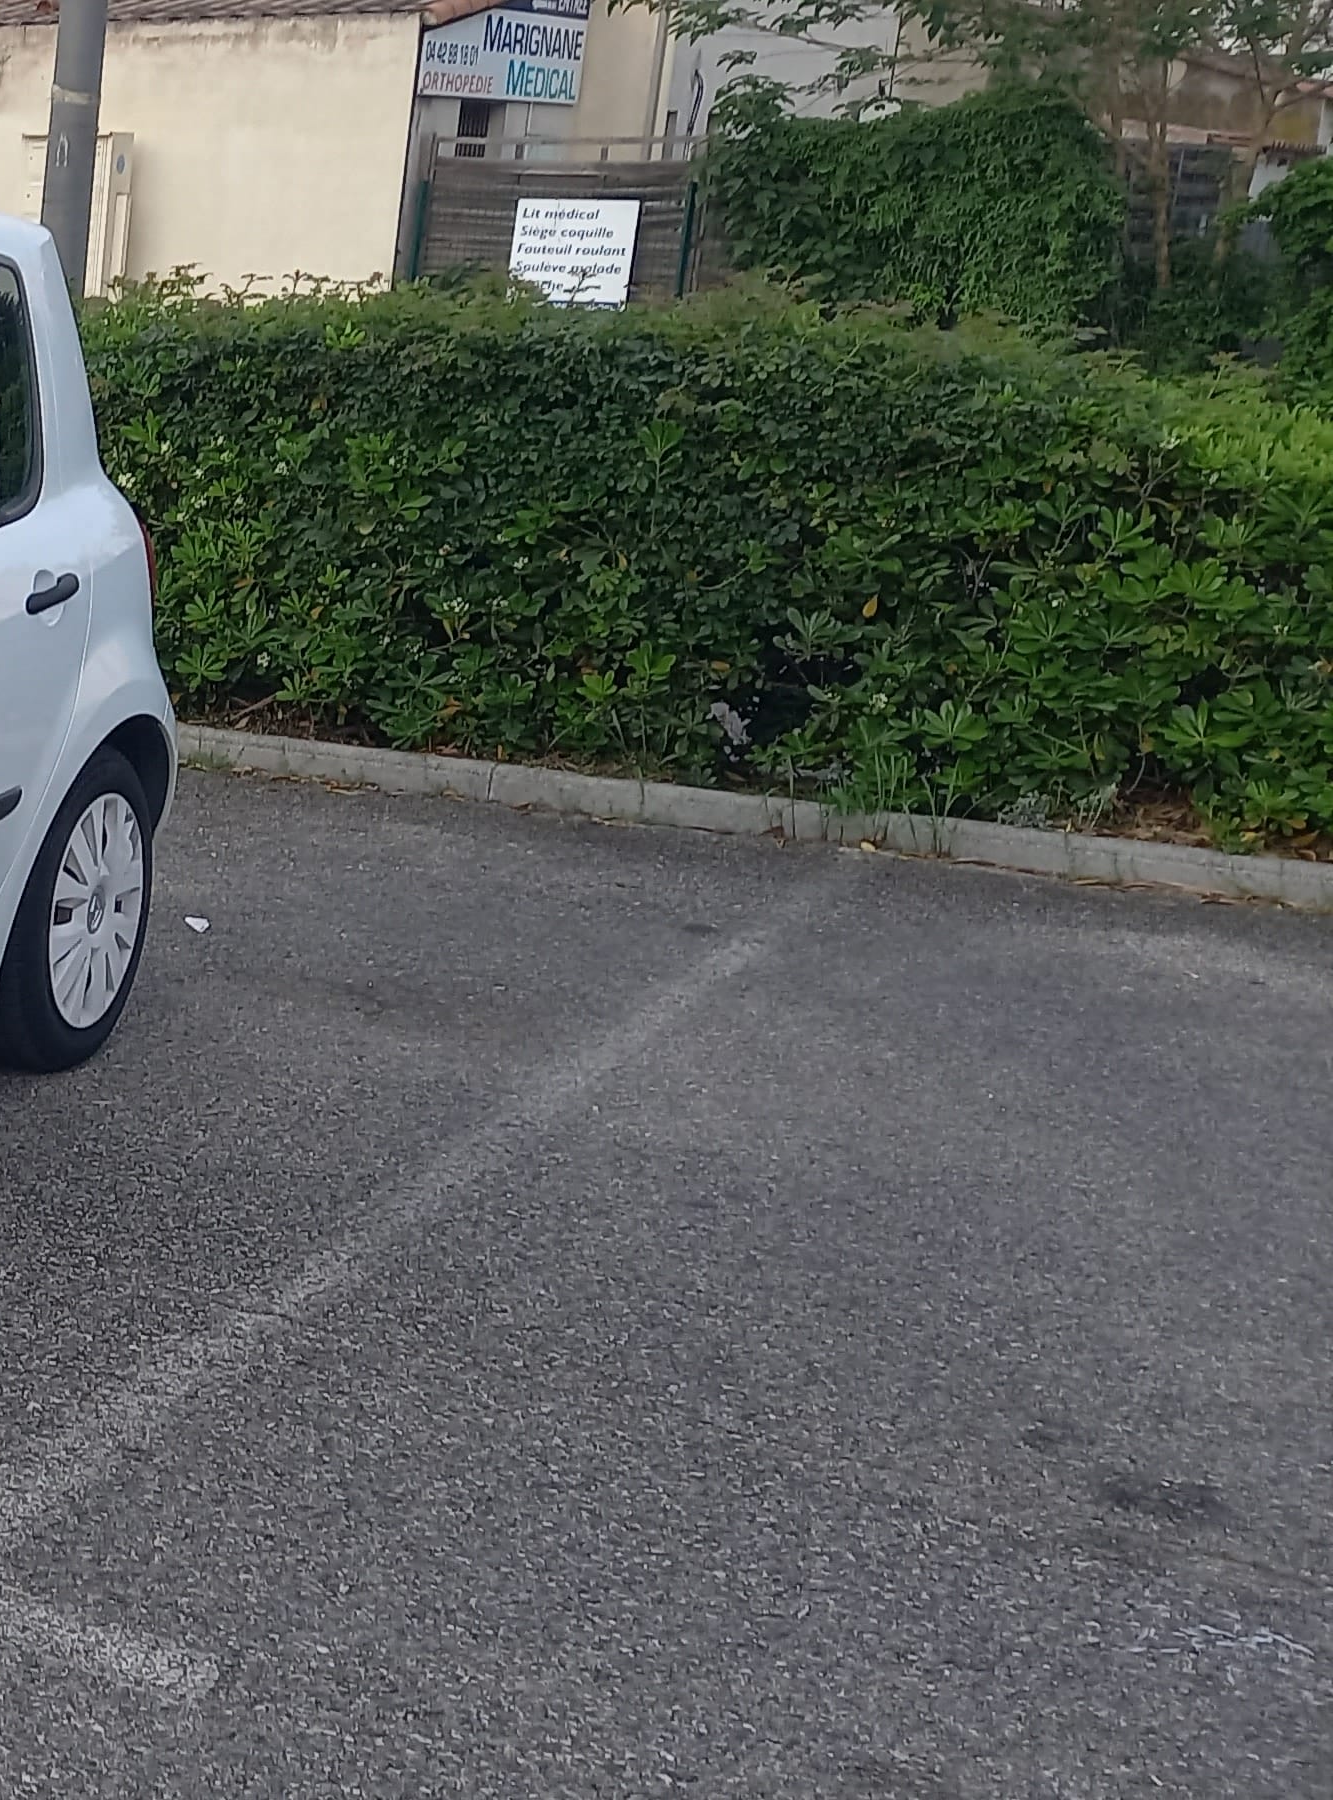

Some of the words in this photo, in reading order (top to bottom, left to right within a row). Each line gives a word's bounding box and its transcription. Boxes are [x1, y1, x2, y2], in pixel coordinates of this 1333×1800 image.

[483, 14, 584, 61] MARIGNANE
[425, 40, 436, 62] 04
[437, 42, 447, 64] 42
[422, 71, 493, 94] ORTHOPEDIE
[505, 59, 575, 100] MEDICAL
[522, 207, 540, 219] Lit
[544, 208, 600, 220] médical
[520, 225, 557, 240] Siège
[560, 227, 614, 241] coquille
[516, 243, 572, 256] Fauteuil
[575, 245, 626, 257] roulant
[515, 261, 566, 273] Soulève
[569, 263, 622, 275] malade
